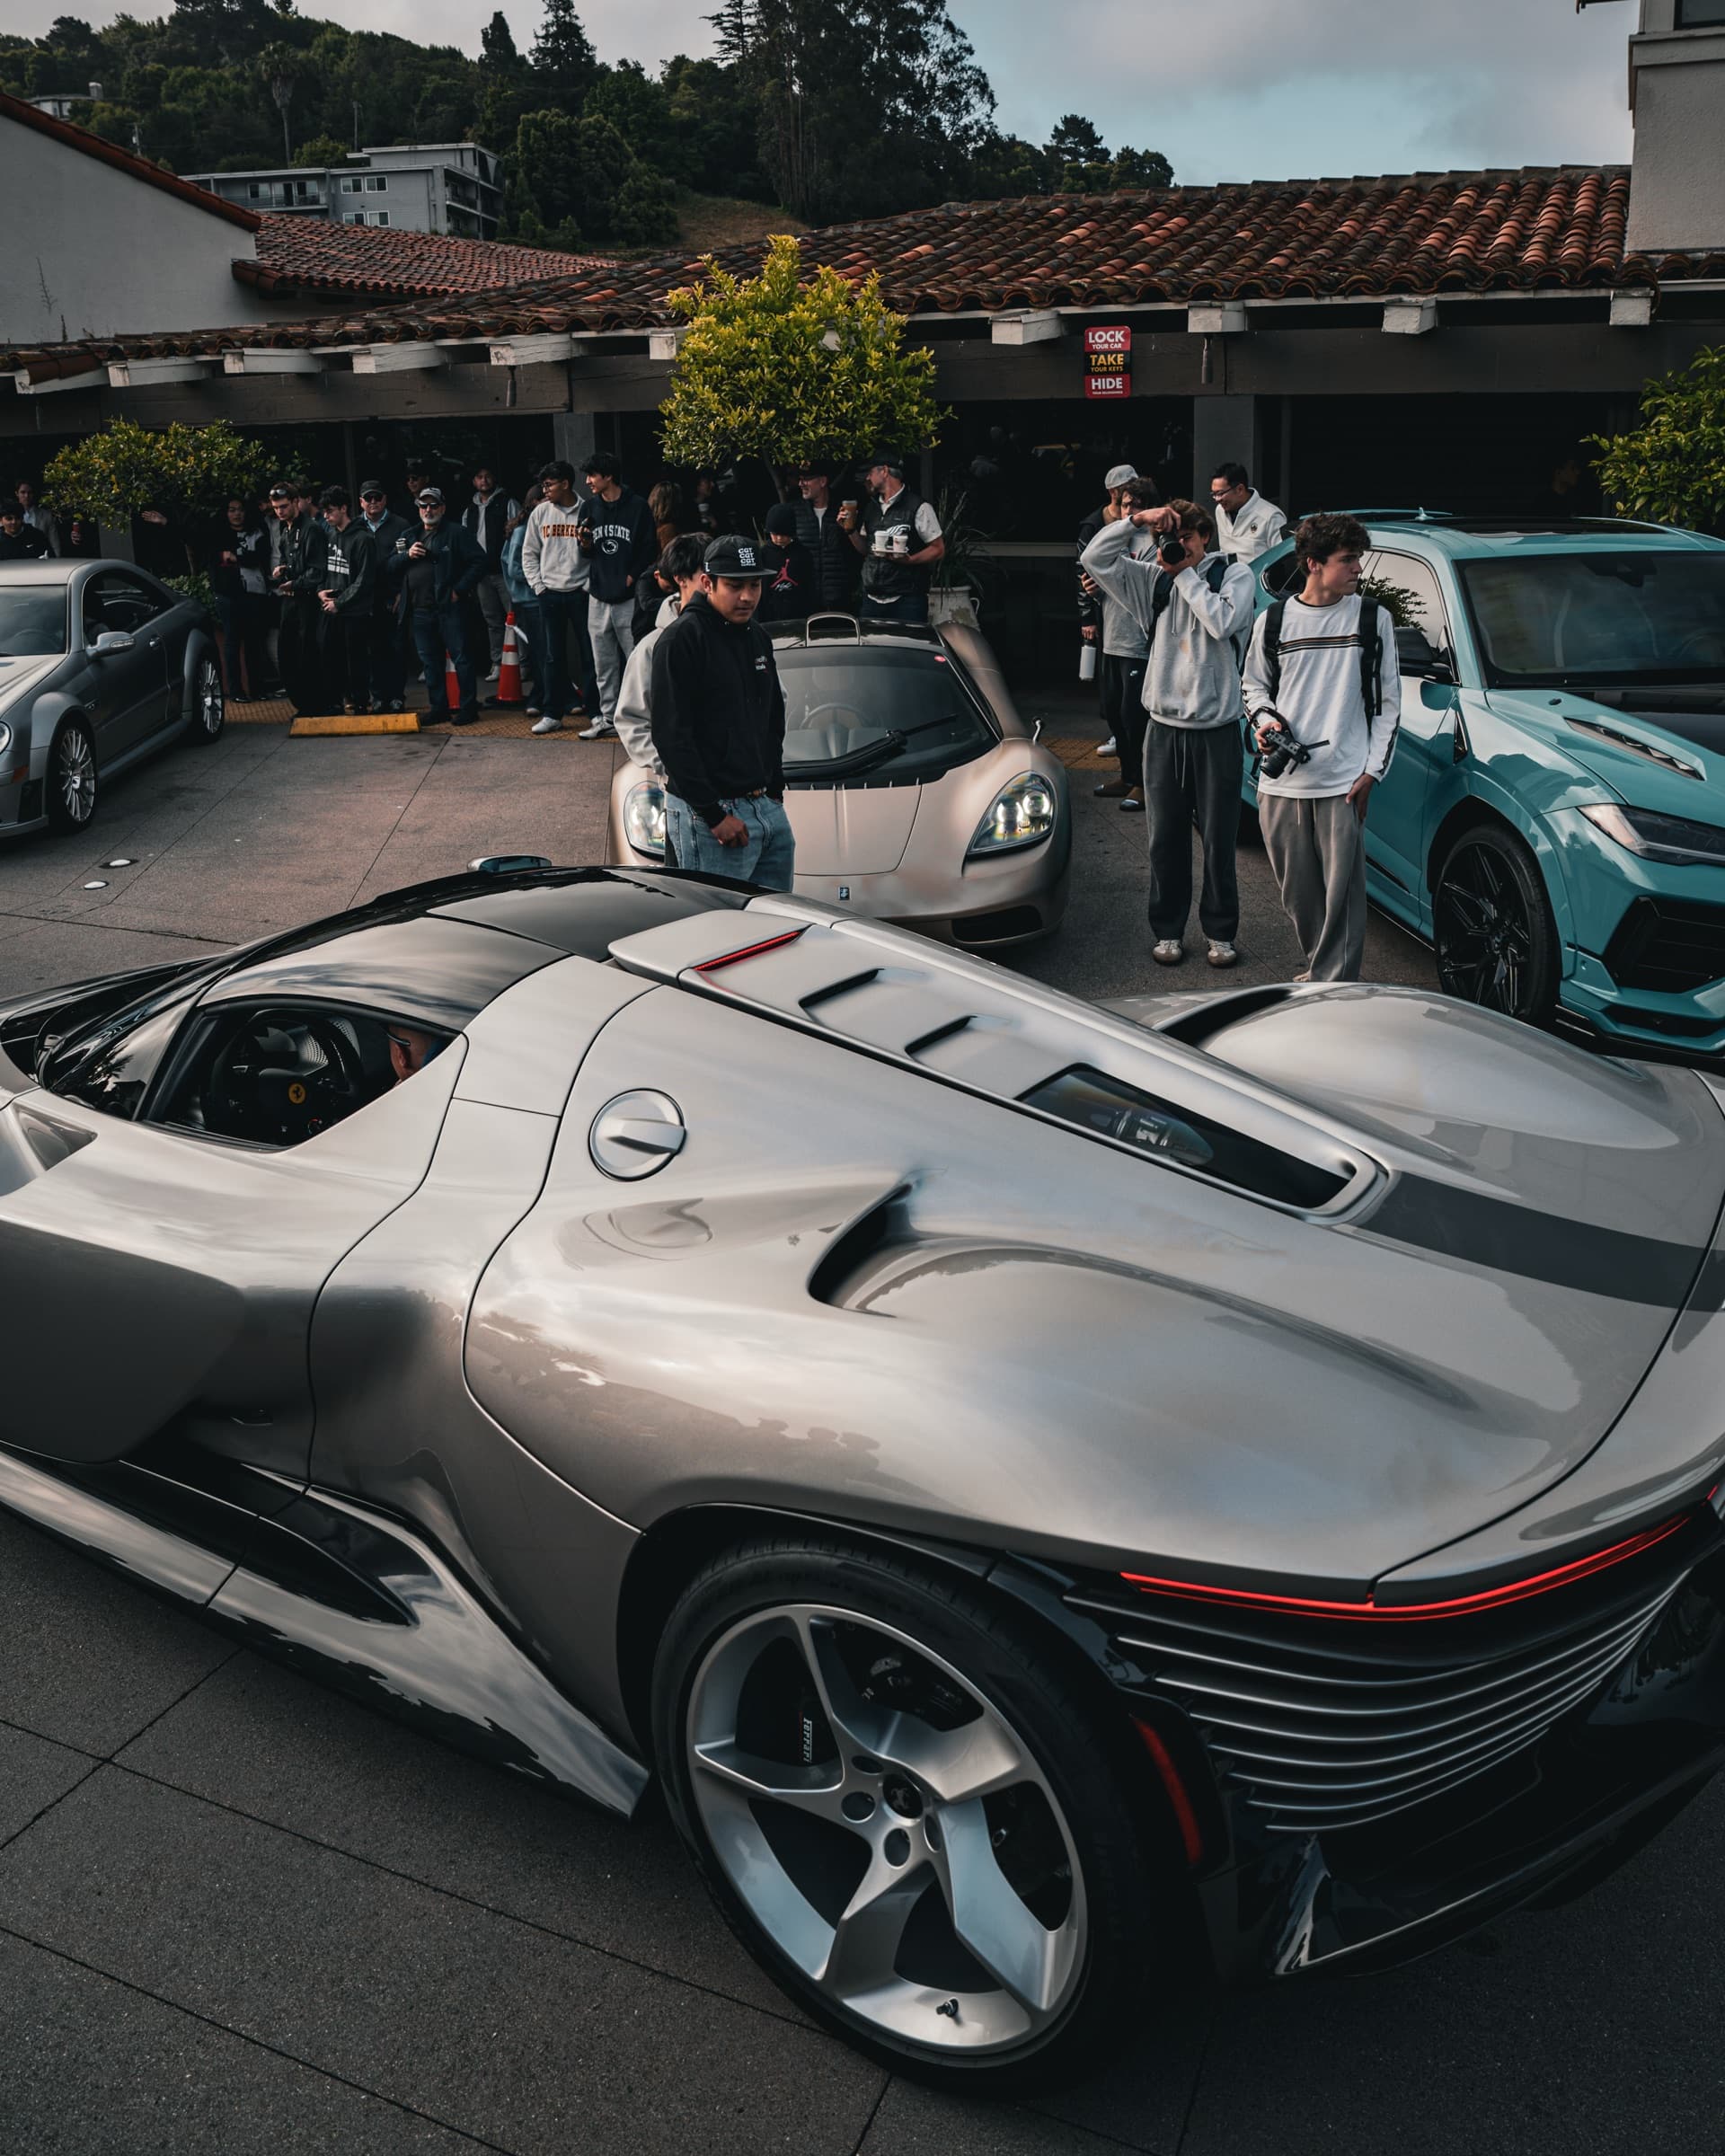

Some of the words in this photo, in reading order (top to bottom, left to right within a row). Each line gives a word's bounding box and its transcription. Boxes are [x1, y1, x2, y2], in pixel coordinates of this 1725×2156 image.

[1088, 331, 1125, 343] LOCK
[1090, 353, 1124, 366] TAKE
[1091, 377, 1123, 390] HIDE
[552, 524, 577, 537] BERKE
